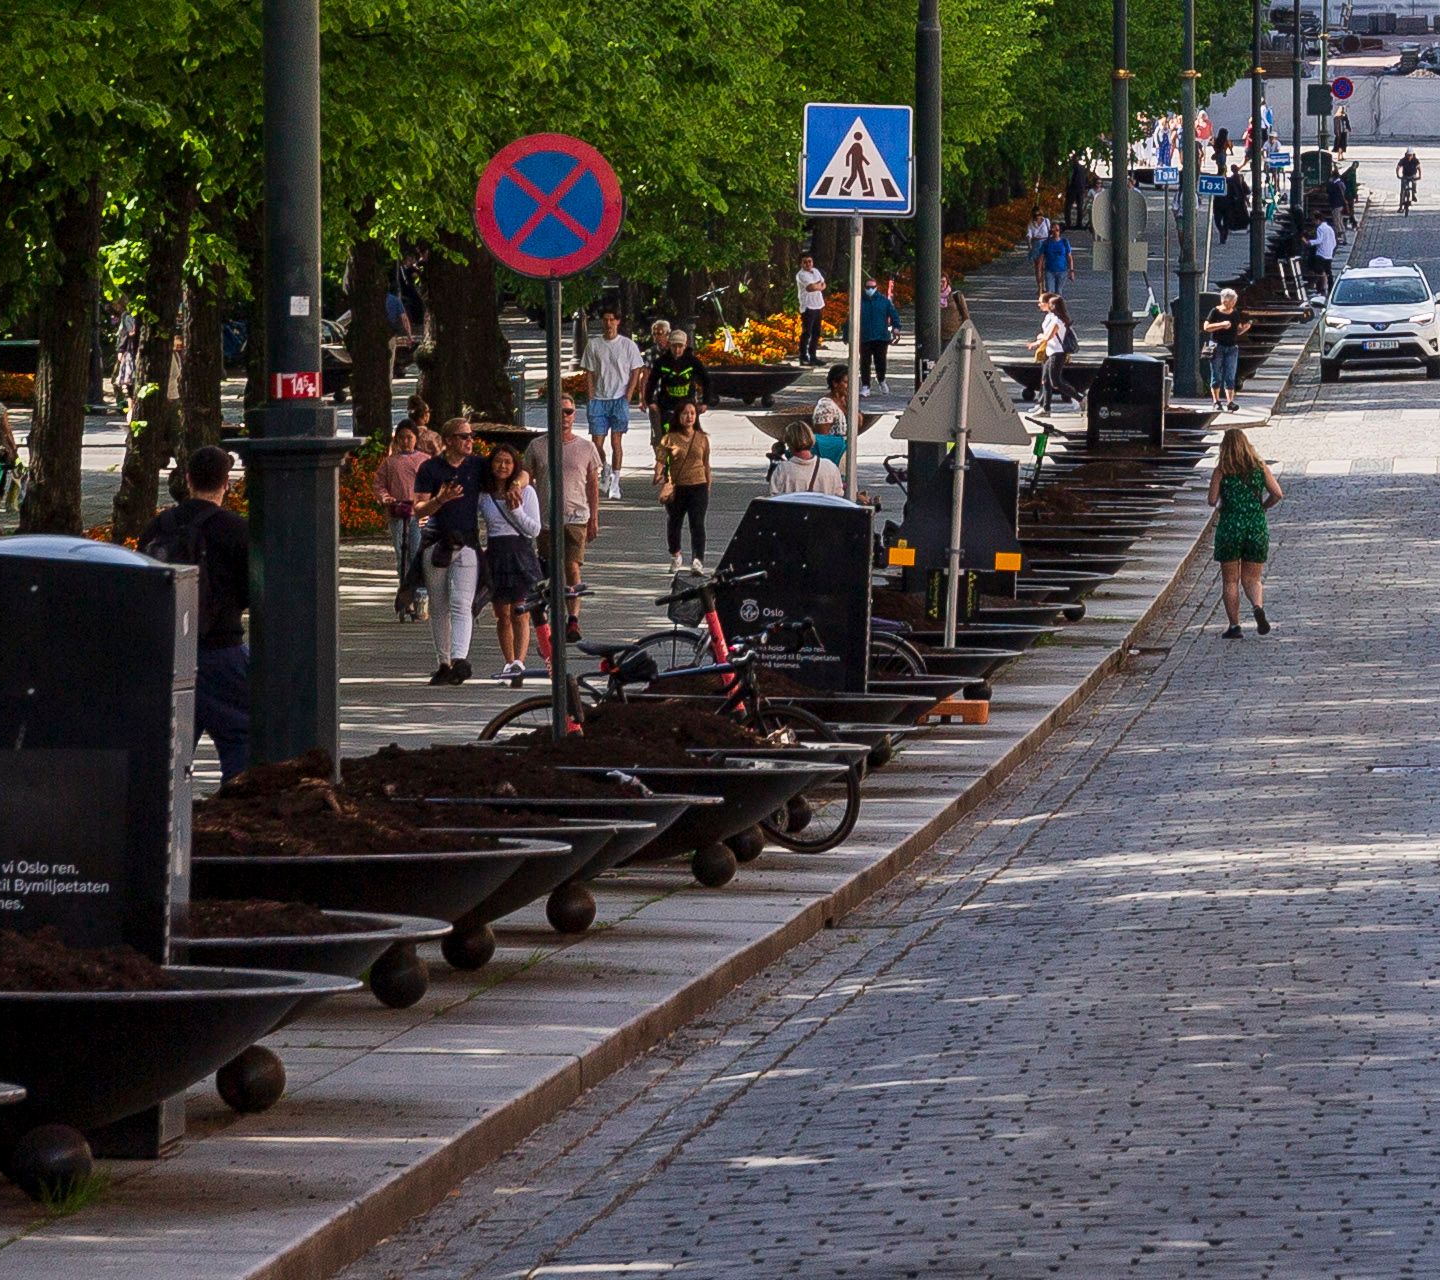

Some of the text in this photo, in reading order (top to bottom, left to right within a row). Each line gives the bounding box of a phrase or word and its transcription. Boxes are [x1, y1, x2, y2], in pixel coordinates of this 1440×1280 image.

[1156, 168, 1177, 180] Taxi
[1201, 179, 1224, 191] Taxi
[762, 607, 784, 617] Oslo
[2, 860, 14, 874] vi
[17, 860, 49, 874] Oslo
[52, 863, 80, 875] ren.
[14, 879, 110, 895] Bymiljøetaten
